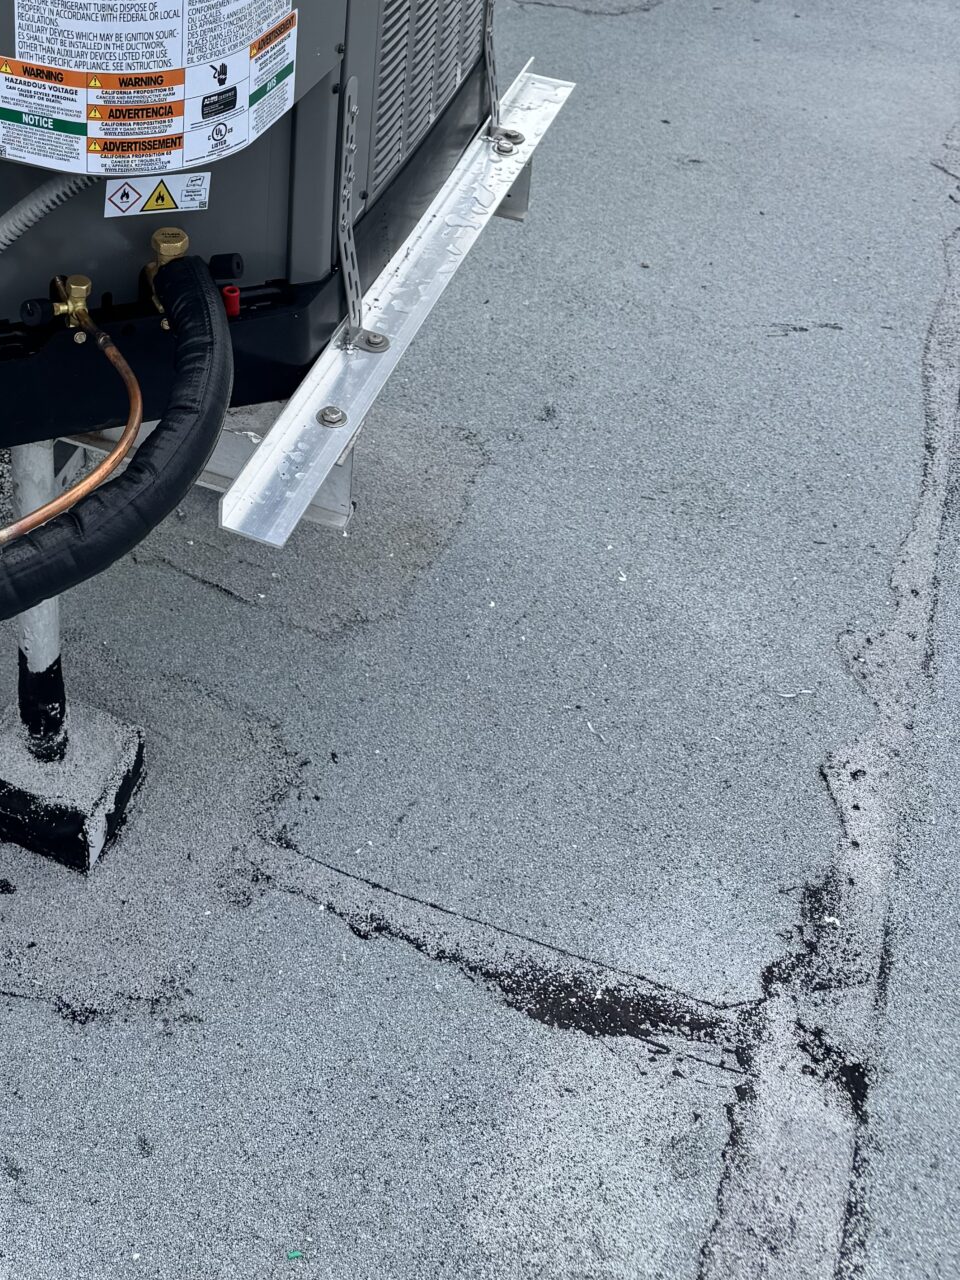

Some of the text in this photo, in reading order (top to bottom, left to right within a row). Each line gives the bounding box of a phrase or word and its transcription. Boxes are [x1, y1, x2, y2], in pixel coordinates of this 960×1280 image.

[17, 2, 180, 22] PROPERLY IN ACCORDANCE WITH FEDERAL OR LOCAL
[51, 0, 93, 11] REFRIGERANT
[94, 3, 118, 12] TUBING
[120, 3, 147, 12] DISPOSE
[149, 2, 157, 11] OF
[18, 12, 59, 27] REGULATIONS.
[188, 23, 197, 31] LES
[18, 22, 179, 41] AUXILIARY DEVICES WHICH MAY BE IGNITION SOURC-
[188, 31, 198, 40] DES
[26, 32, 44, 43] SHALL
[46, 37, 58, 45] NOT
[60, 39, 67, 47] BE
[69, 41, 102, 50] INSTALLED
[18, 41, 168, 60] OTHER THAN AUXILIARY DEVICES LISTED FOR USE
[18, 50, 33, 61] WITH
[35, 53, 46, 63] THE
[47, 56, 72, 68] SPECIFIC
[112, 62, 124, 71] SEE
[22, 65, 64, 82] WARNING
[119, 75, 164, 87] WARNING
[5, 76, 78, 96] HAZARDOUS VOLTAGE
[51, 93, 77, 102] PERSONAL
[108, 106, 173, 119] ADVERTENCIA
[22, 113, 54, 128] NOTICE
[101, 136, 183, 152] ADVERTISSEMENT
[212, 139, 226, 149] LISTED
